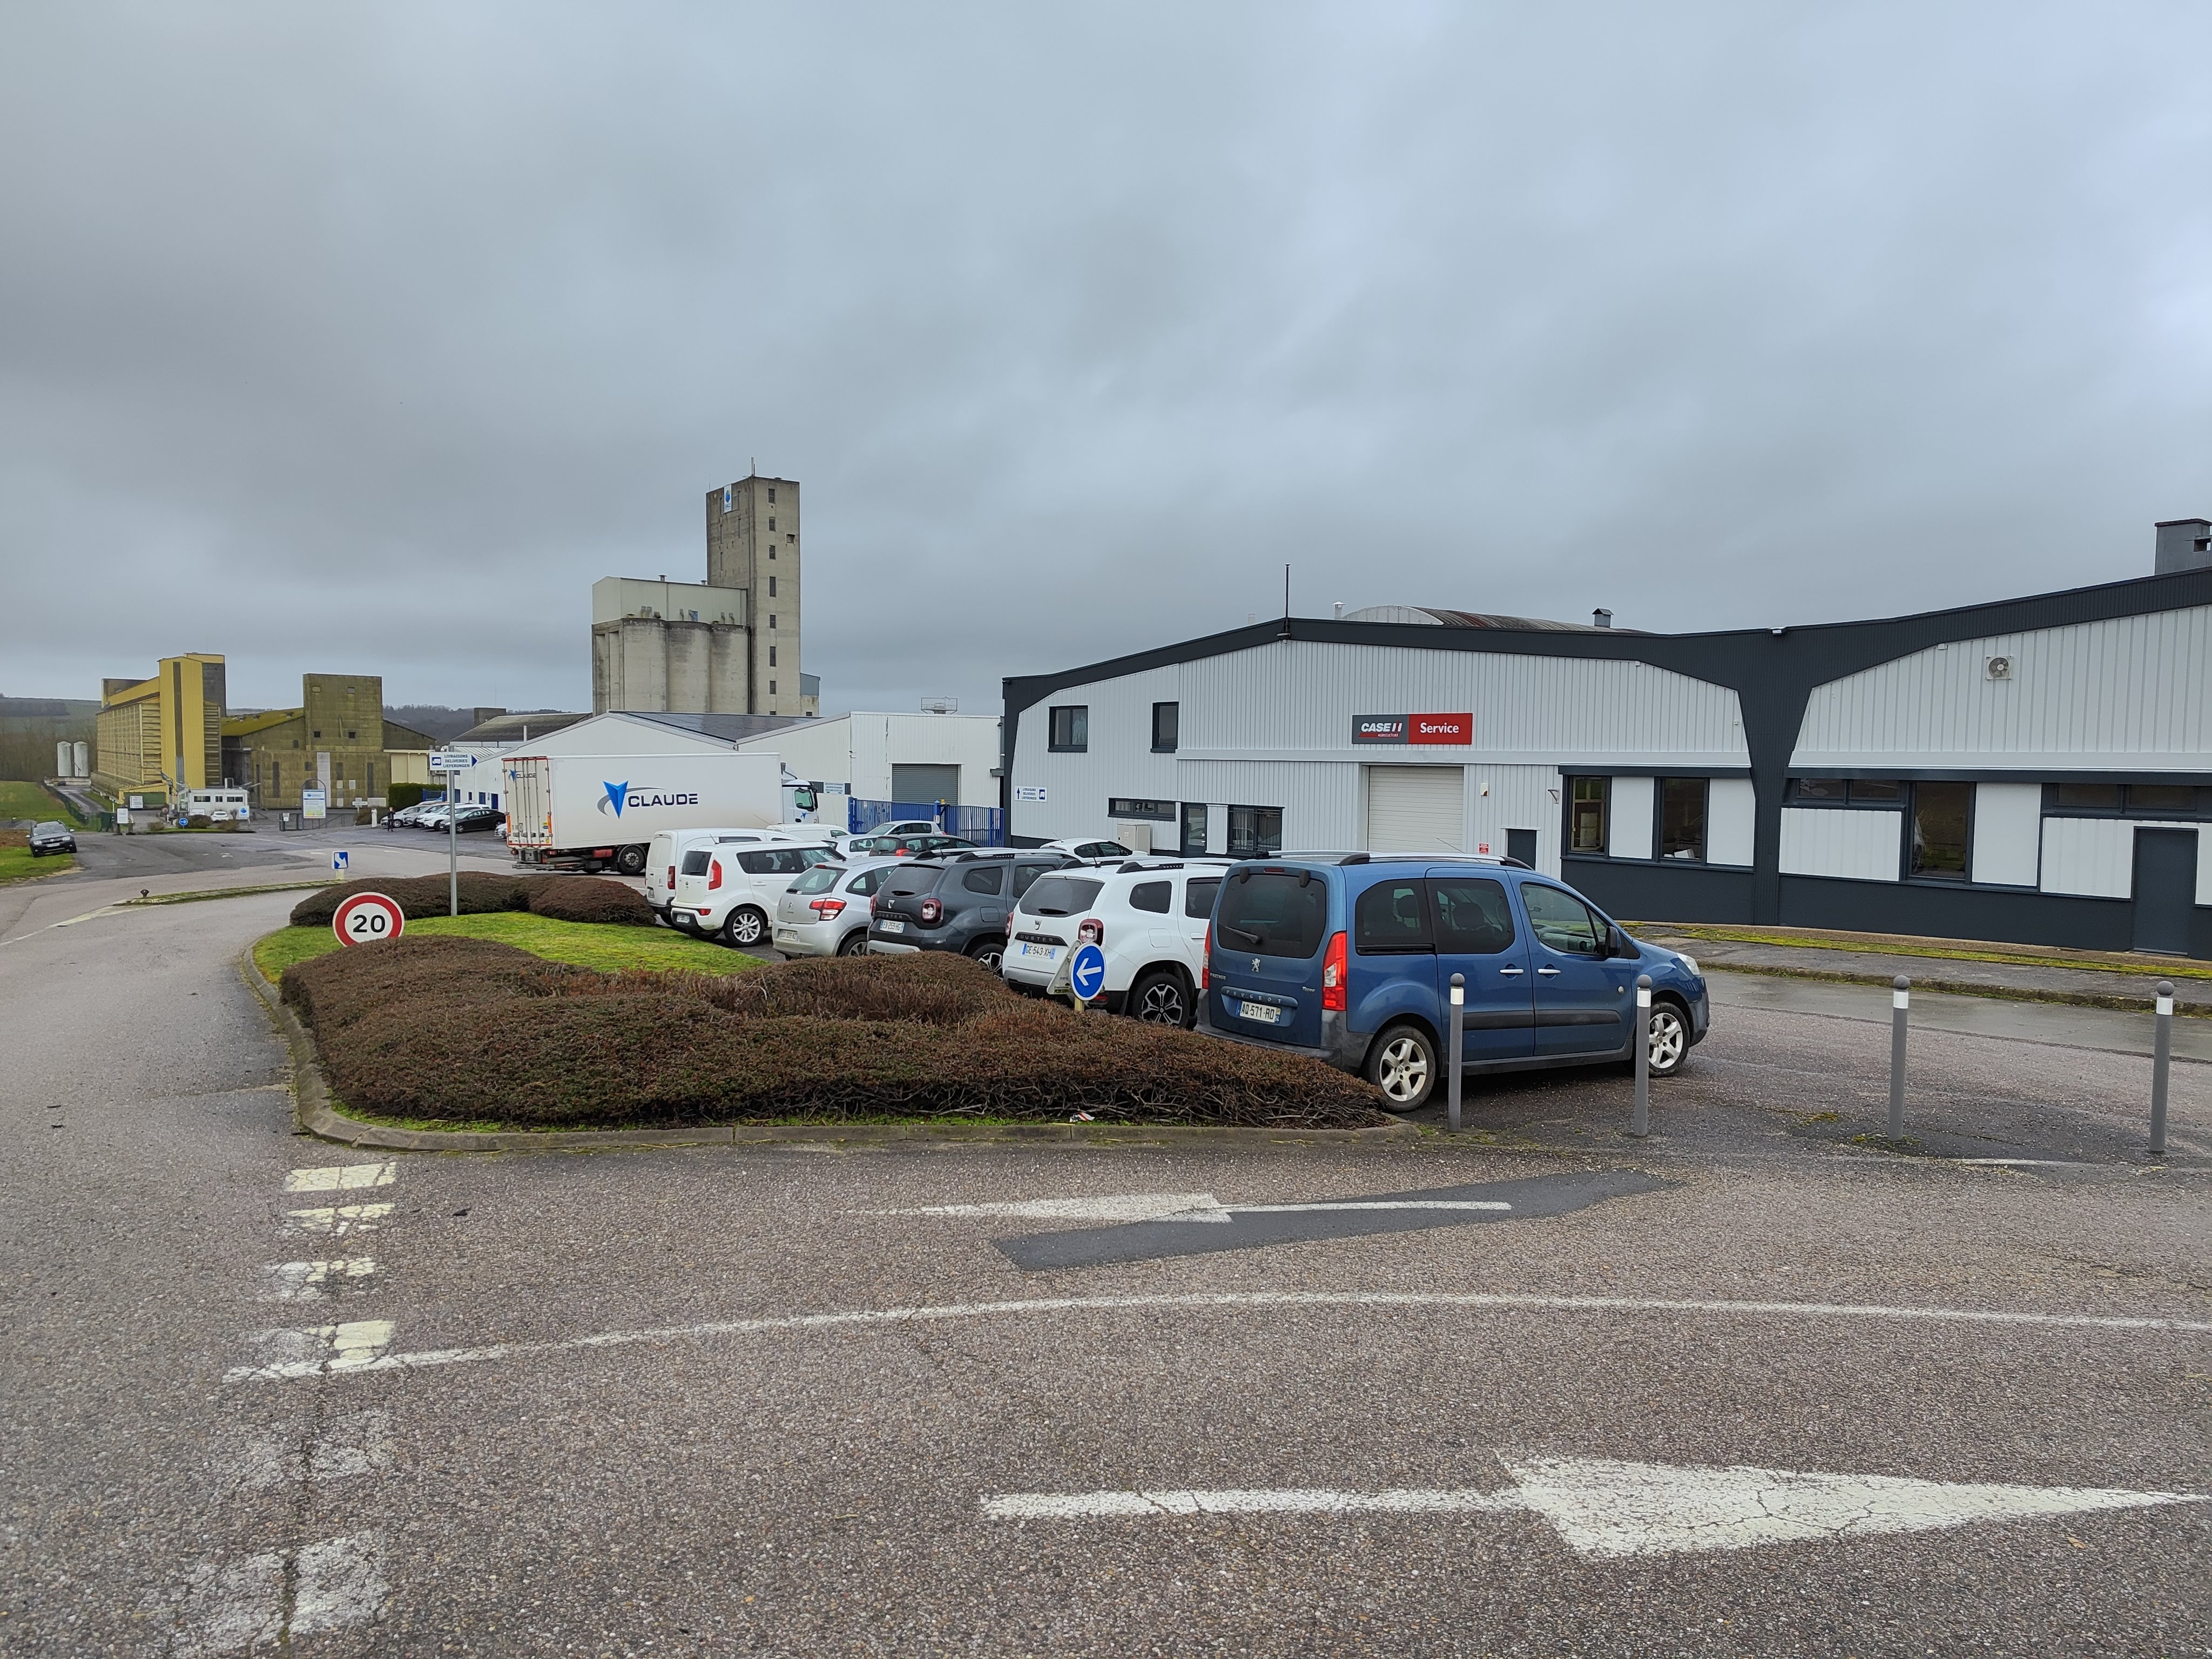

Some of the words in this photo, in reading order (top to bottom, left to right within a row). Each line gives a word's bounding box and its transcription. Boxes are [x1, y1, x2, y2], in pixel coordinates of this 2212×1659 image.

[1360, 723, 1392, 732] CASE
[1420, 722, 1459, 733] Service
[628, 793, 699, 807] CLAUDE
[353, 914, 386, 933] 20
[1020, 934, 1054, 942] DUSTER
[1226, 989, 1282, 1003] PEUGEOT
